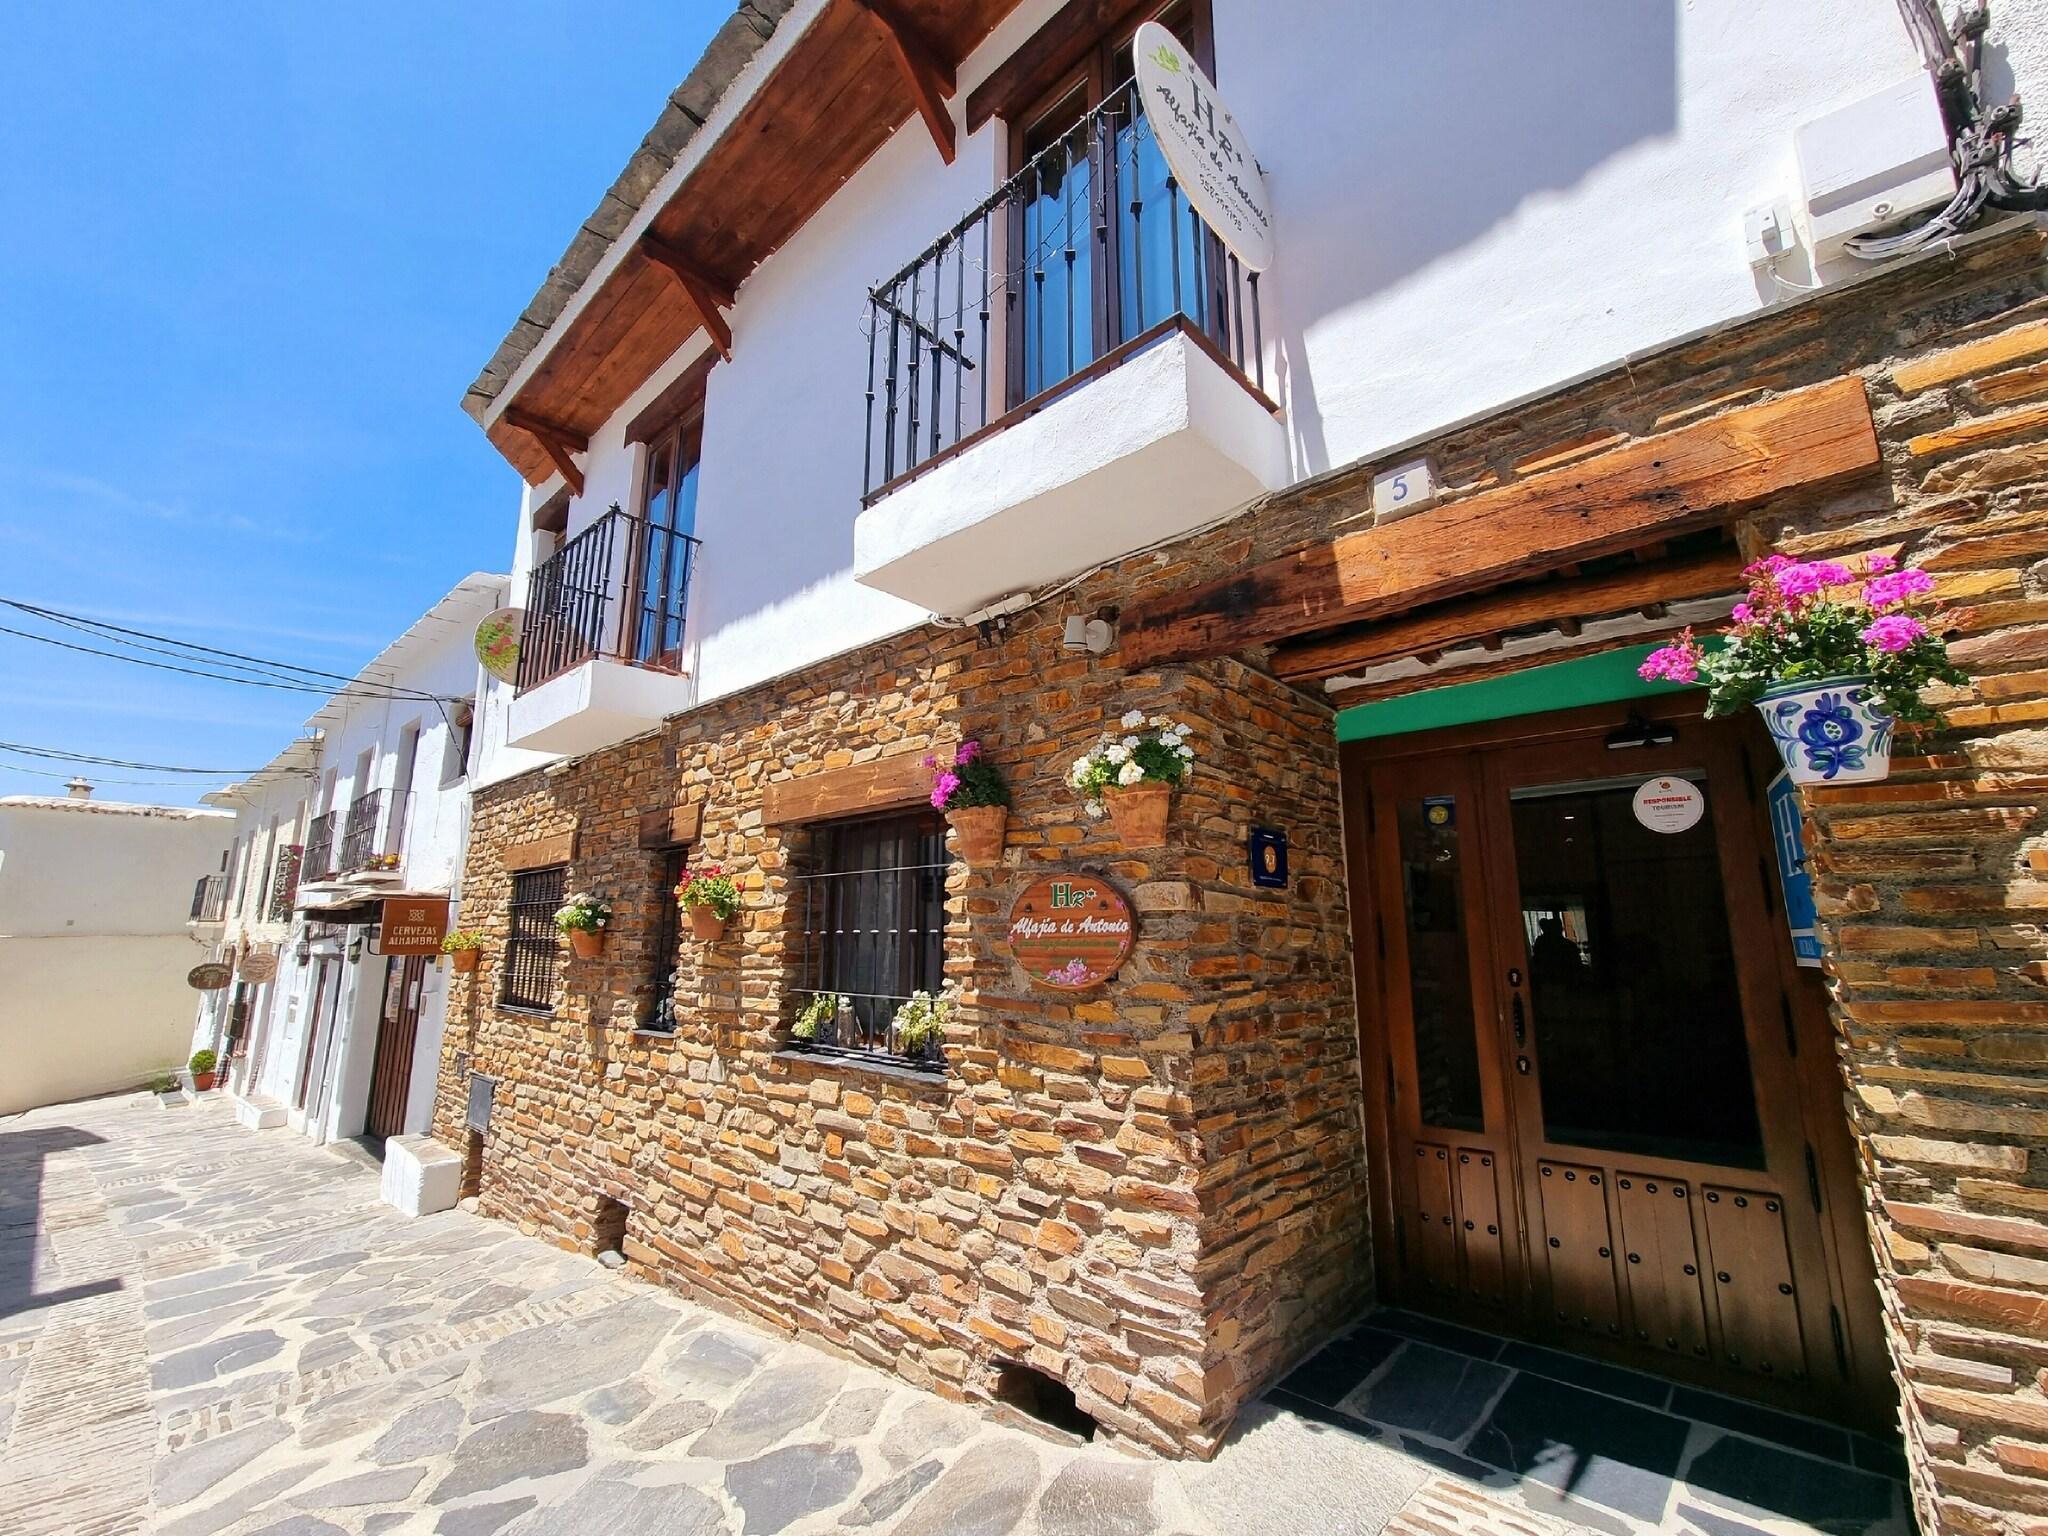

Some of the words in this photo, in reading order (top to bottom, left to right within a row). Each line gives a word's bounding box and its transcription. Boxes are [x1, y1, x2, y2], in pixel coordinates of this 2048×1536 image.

[1209, 150, 1223, 172] de
[1227, 174, 1269, 228] Antonio
[1391, 474, 1408, 502] 5
[392, 926, 437, 935] CERVEZAS
[1060, 918, 1074, 933] de
[1077, 915, 1129, 934] Antonio
[388, 936, 438, 945] ALHAMBRA
